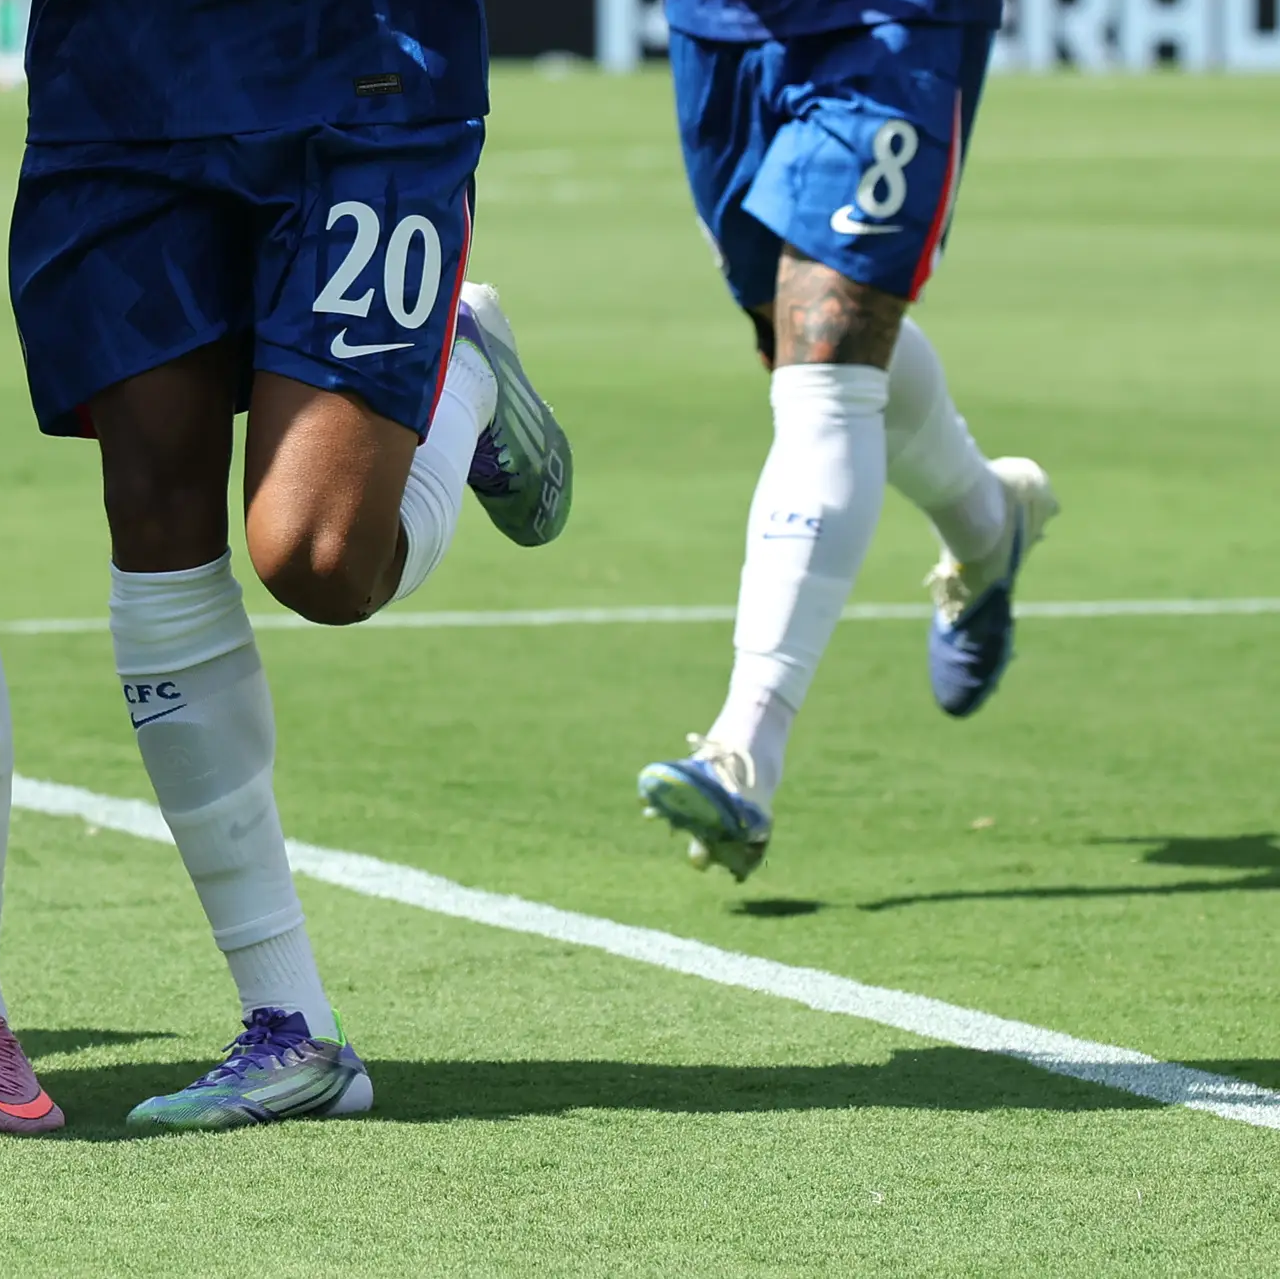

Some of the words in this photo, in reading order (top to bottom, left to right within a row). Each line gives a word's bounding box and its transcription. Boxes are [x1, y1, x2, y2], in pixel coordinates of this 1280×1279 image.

[855, 117, 919, 219] 8
[312, 200, 442, 330] 20
[124, 681, 181, 704] CFC
